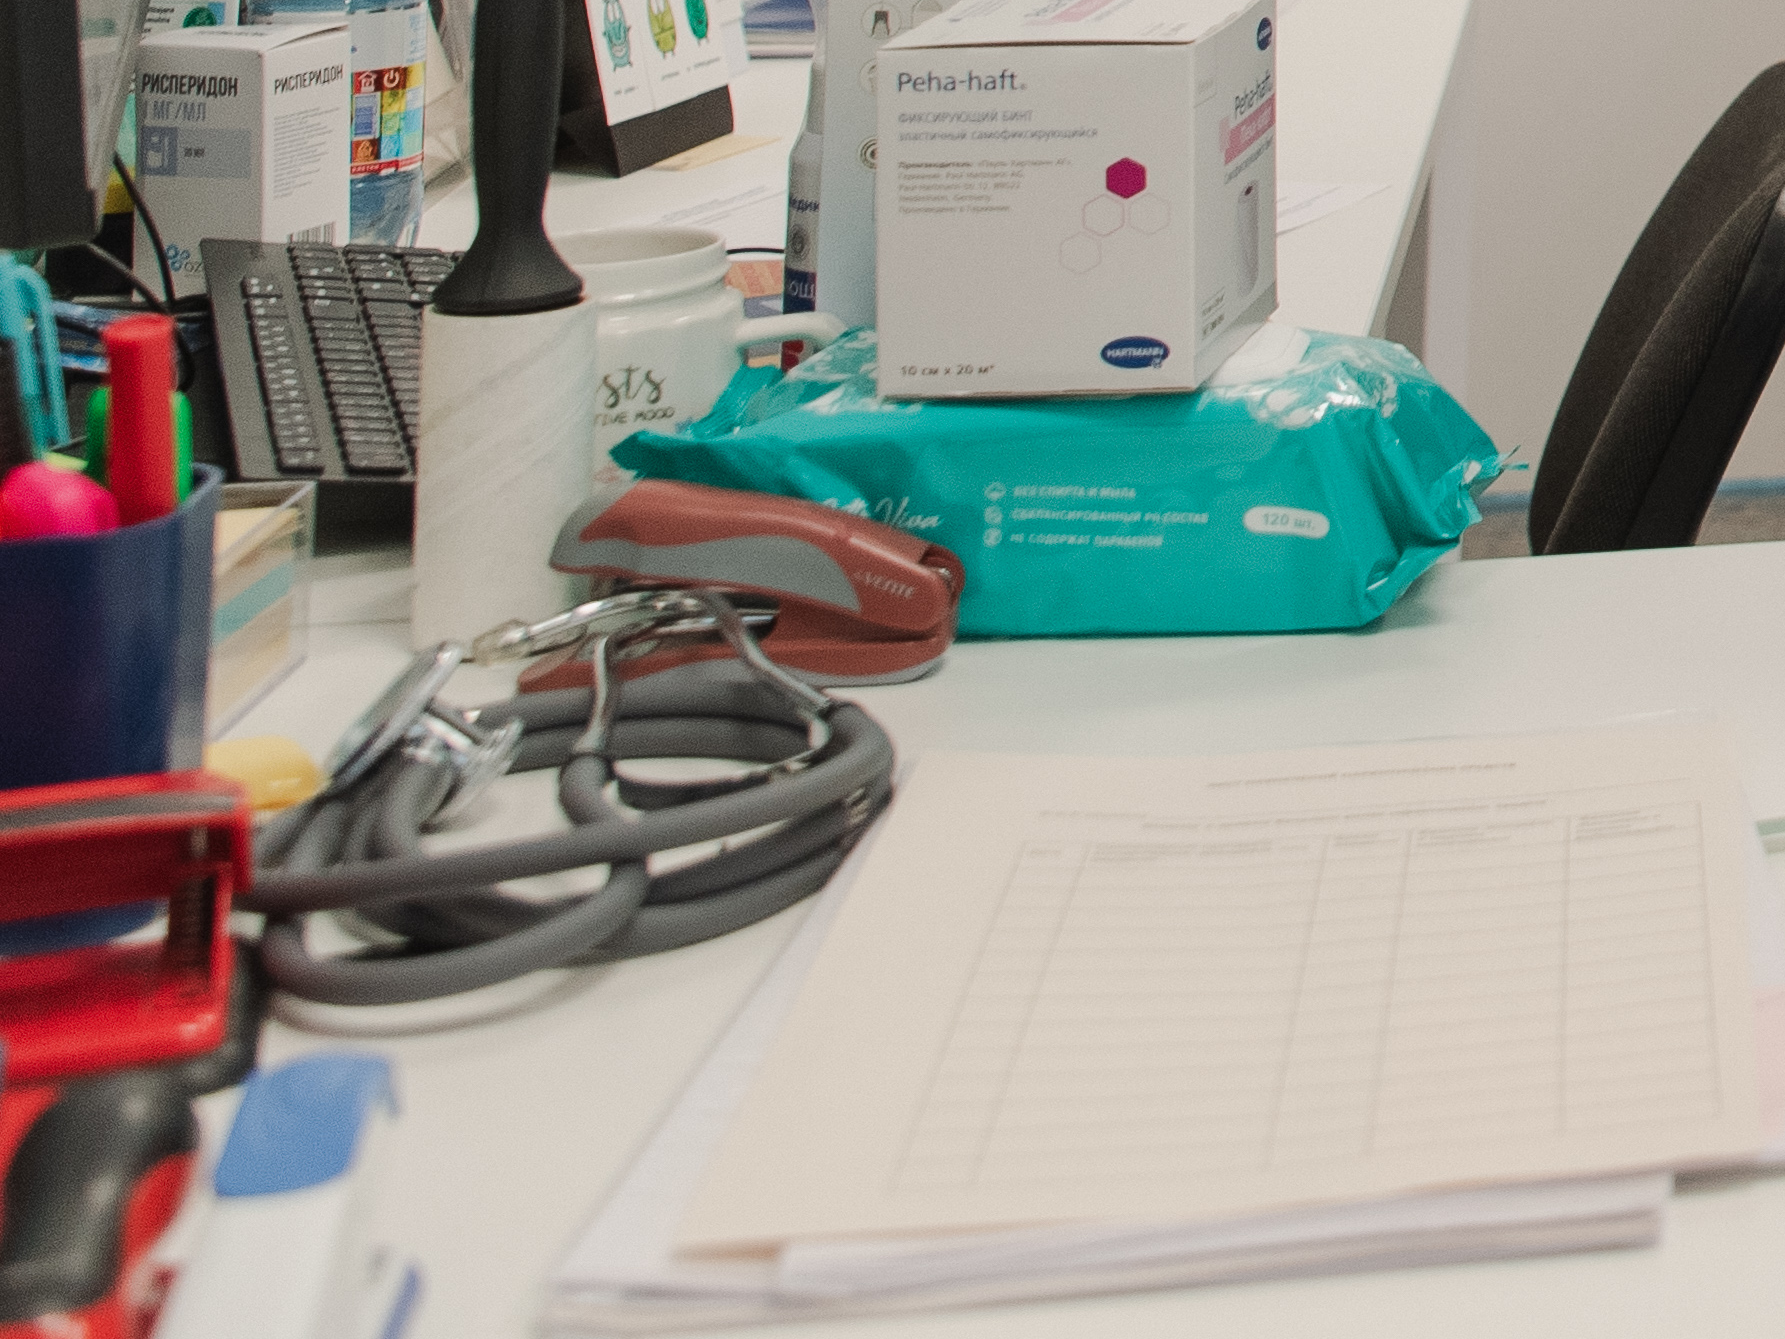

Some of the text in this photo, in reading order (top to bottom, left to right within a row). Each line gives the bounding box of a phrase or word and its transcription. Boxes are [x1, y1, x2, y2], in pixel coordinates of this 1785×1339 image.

[141, 72, 239, 98] РИСПЕРИДОН
[273, 64, 345, 95] РИСПЕРИДОН
[152, 100, 207, 122] МГ/МЛ
[898, 109, 1033, 123] ФИКСИРУЮЩИЙ БИНТ
[634, 406, 677, 423] MOOD
[1262, 512, 1290, 527] 120
